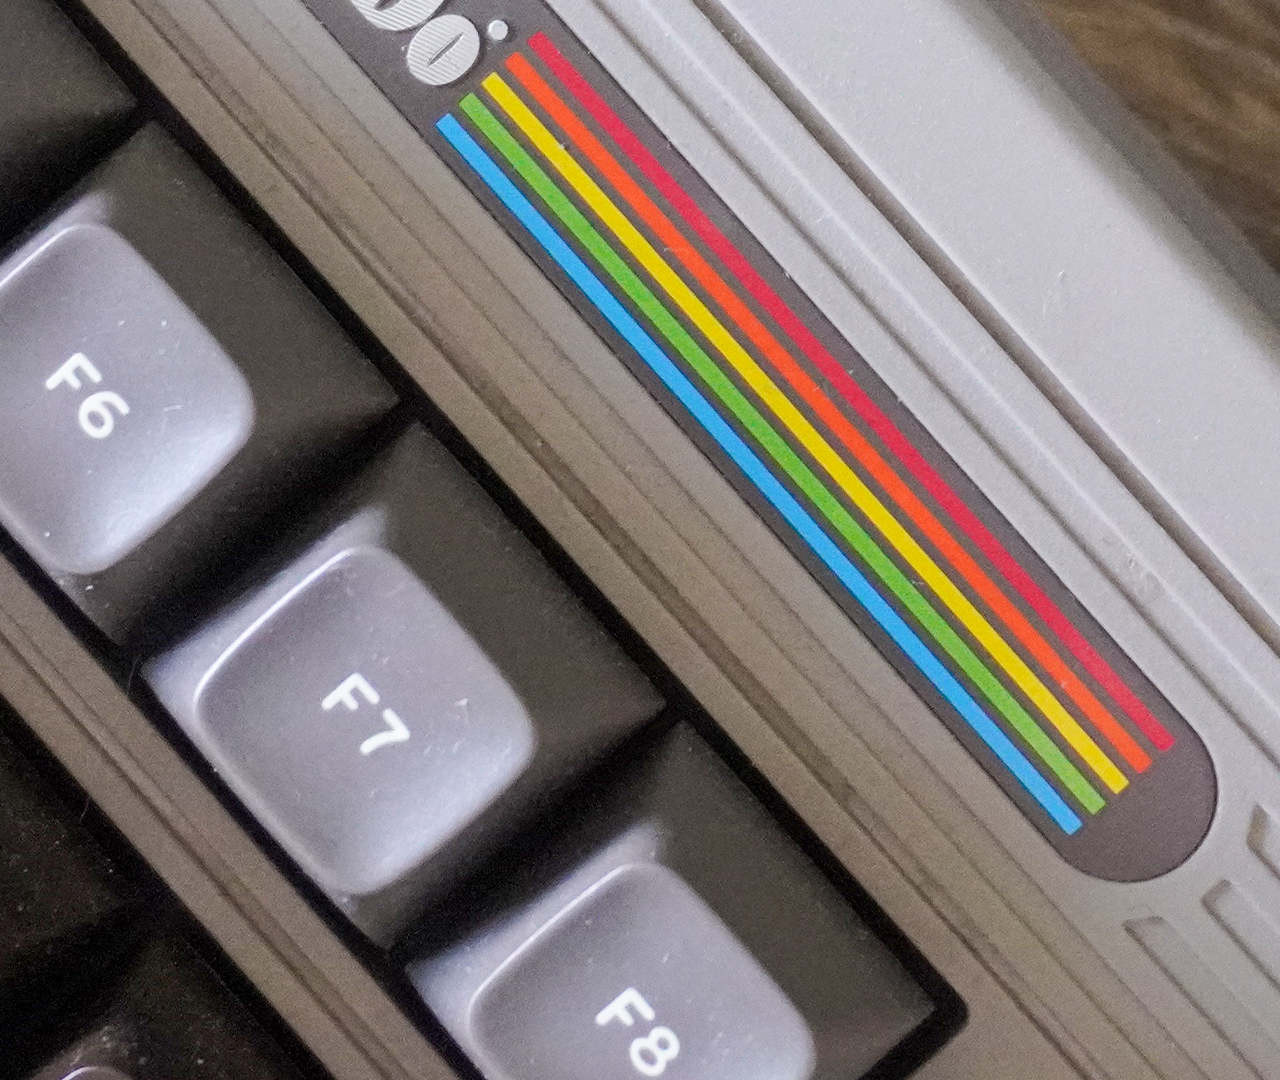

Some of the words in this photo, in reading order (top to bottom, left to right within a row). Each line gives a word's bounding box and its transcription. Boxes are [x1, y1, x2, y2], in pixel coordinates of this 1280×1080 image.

[45, 351, 130, 440] F6
[321, 673, 410, 755] F7
[595, 987, 681, 1079] F8
